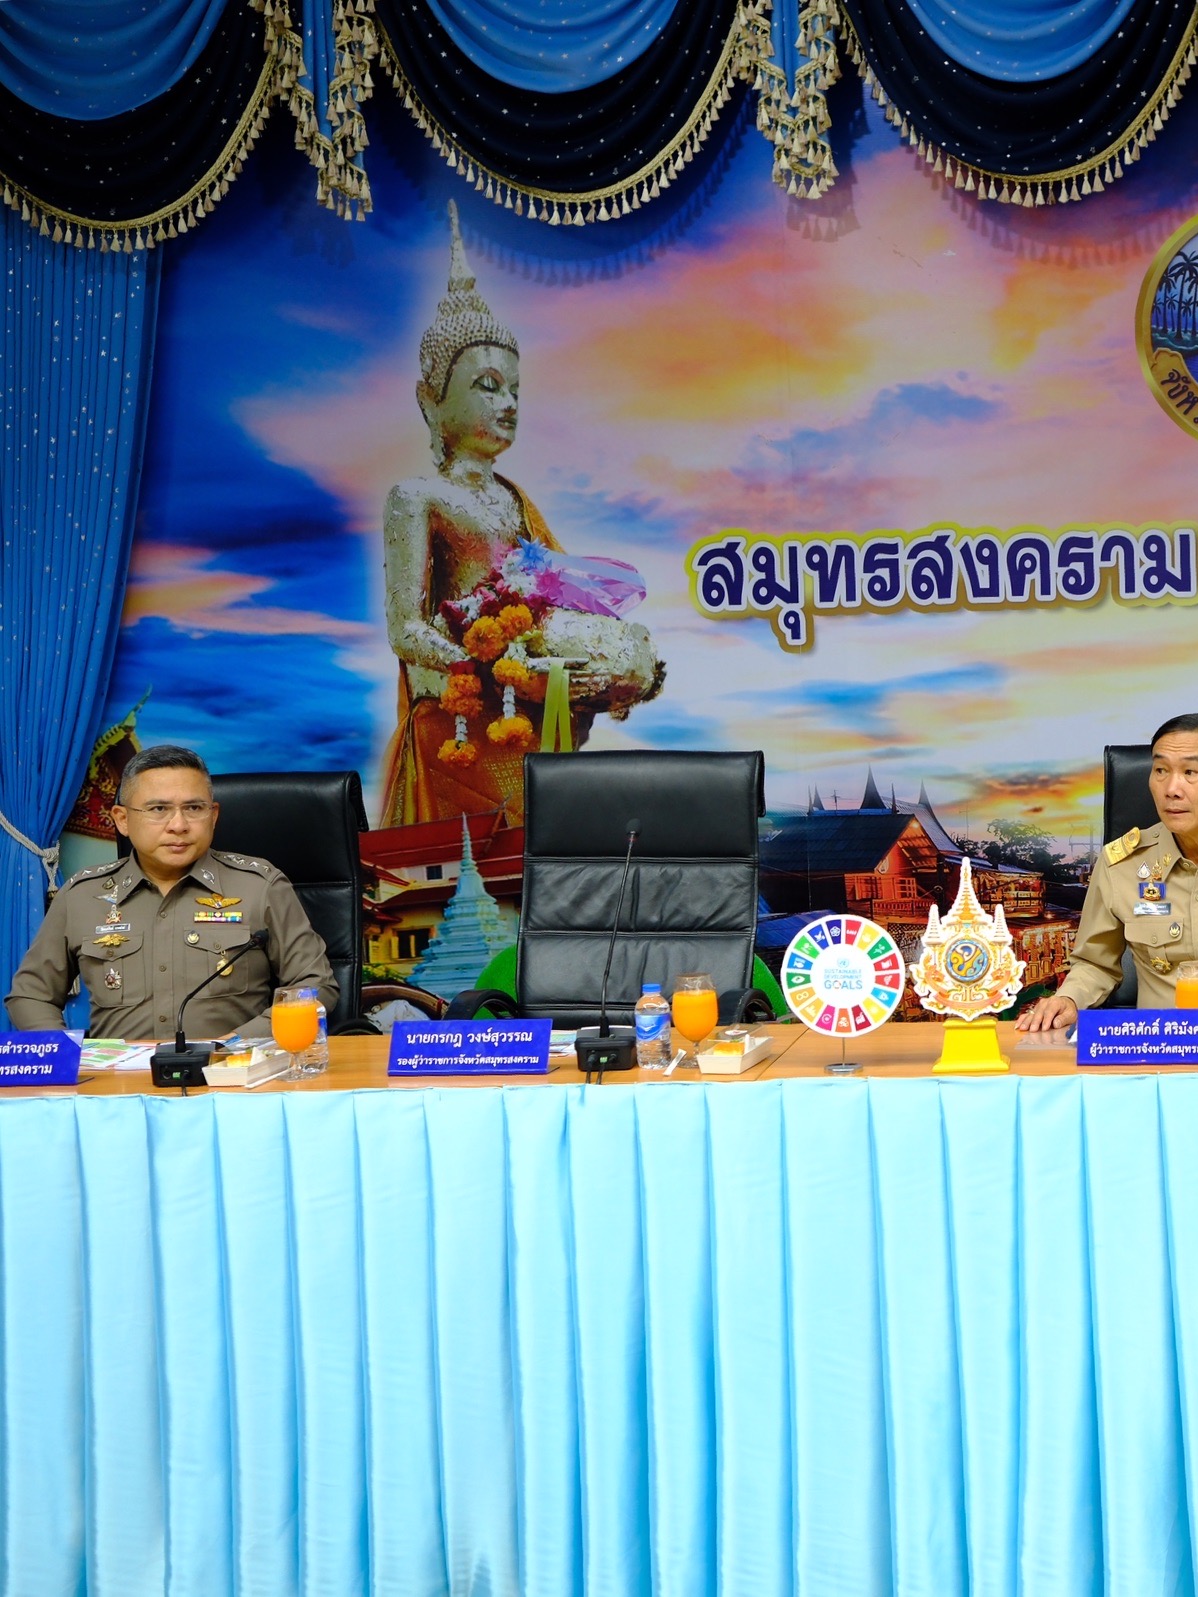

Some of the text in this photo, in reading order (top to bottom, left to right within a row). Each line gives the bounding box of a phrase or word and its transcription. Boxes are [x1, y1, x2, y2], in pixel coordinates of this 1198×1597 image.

[697, 532, 1198, 641] สมุทรสงคราม
[824, 979, 863, 990] GOALS
